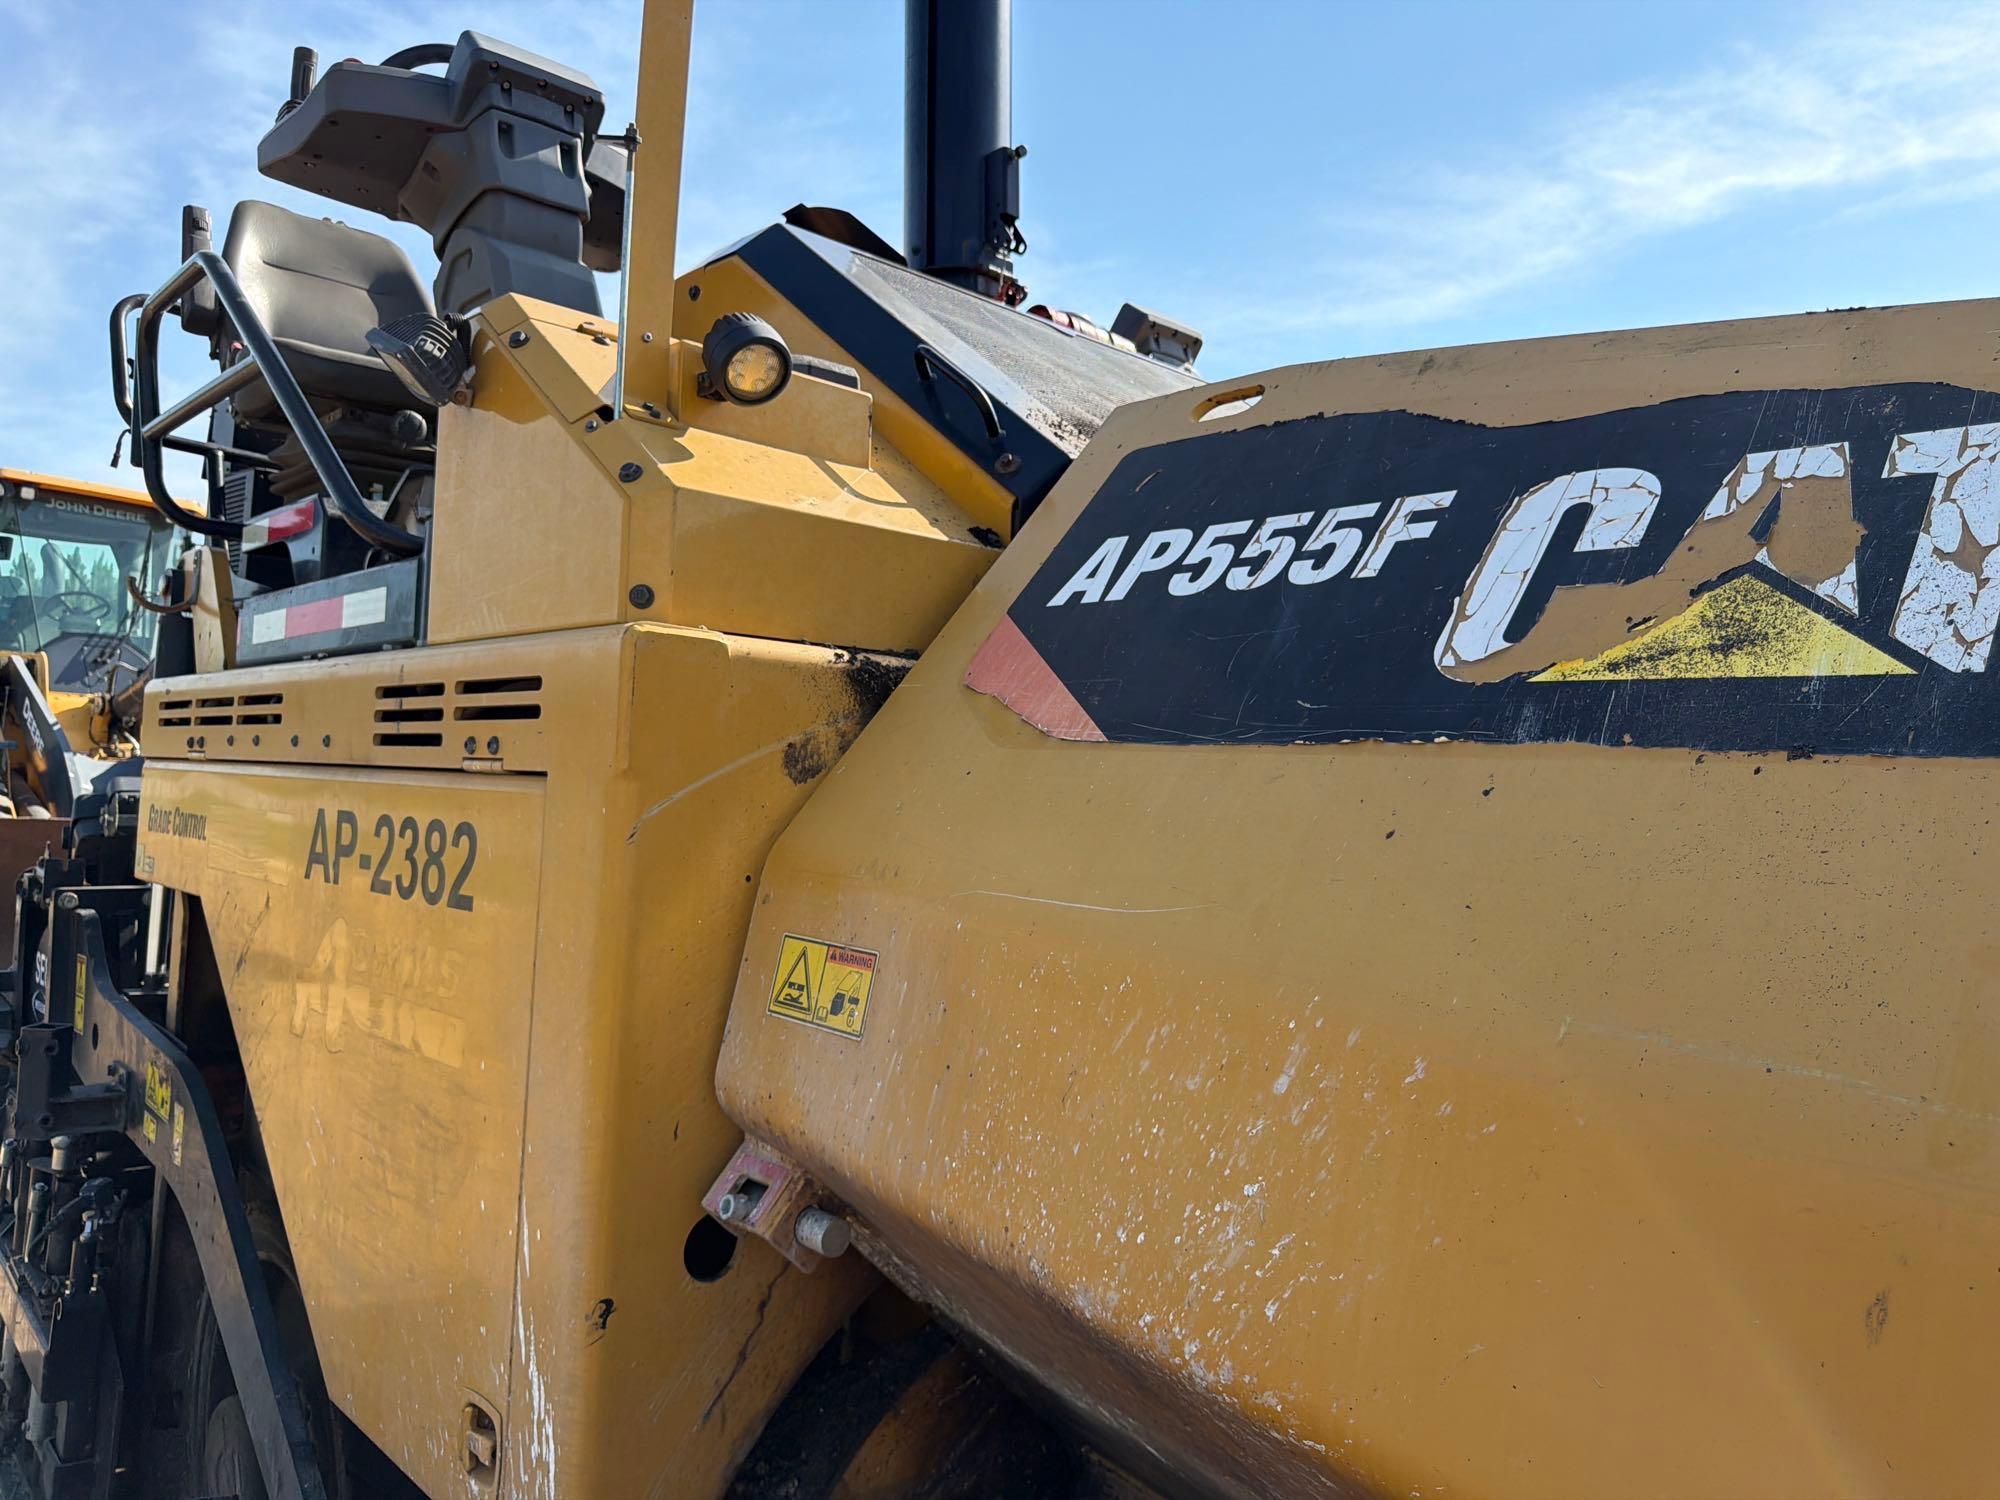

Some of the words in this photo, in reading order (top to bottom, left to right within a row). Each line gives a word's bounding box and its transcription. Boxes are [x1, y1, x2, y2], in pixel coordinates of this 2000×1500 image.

[46, 498, 90, 514] JOHN
[94, 505, 145, 523] DEERE
[1046, 490, 1457, 607] AP555F
[1434, 423, 2000, 684] CAT
[148, 803, 172, 835] GRADE
[173, 806, 207, 841] CONTROL
[304, 808, 477, 912] AP-2382
[838, 951, 873, 969] WARNING
